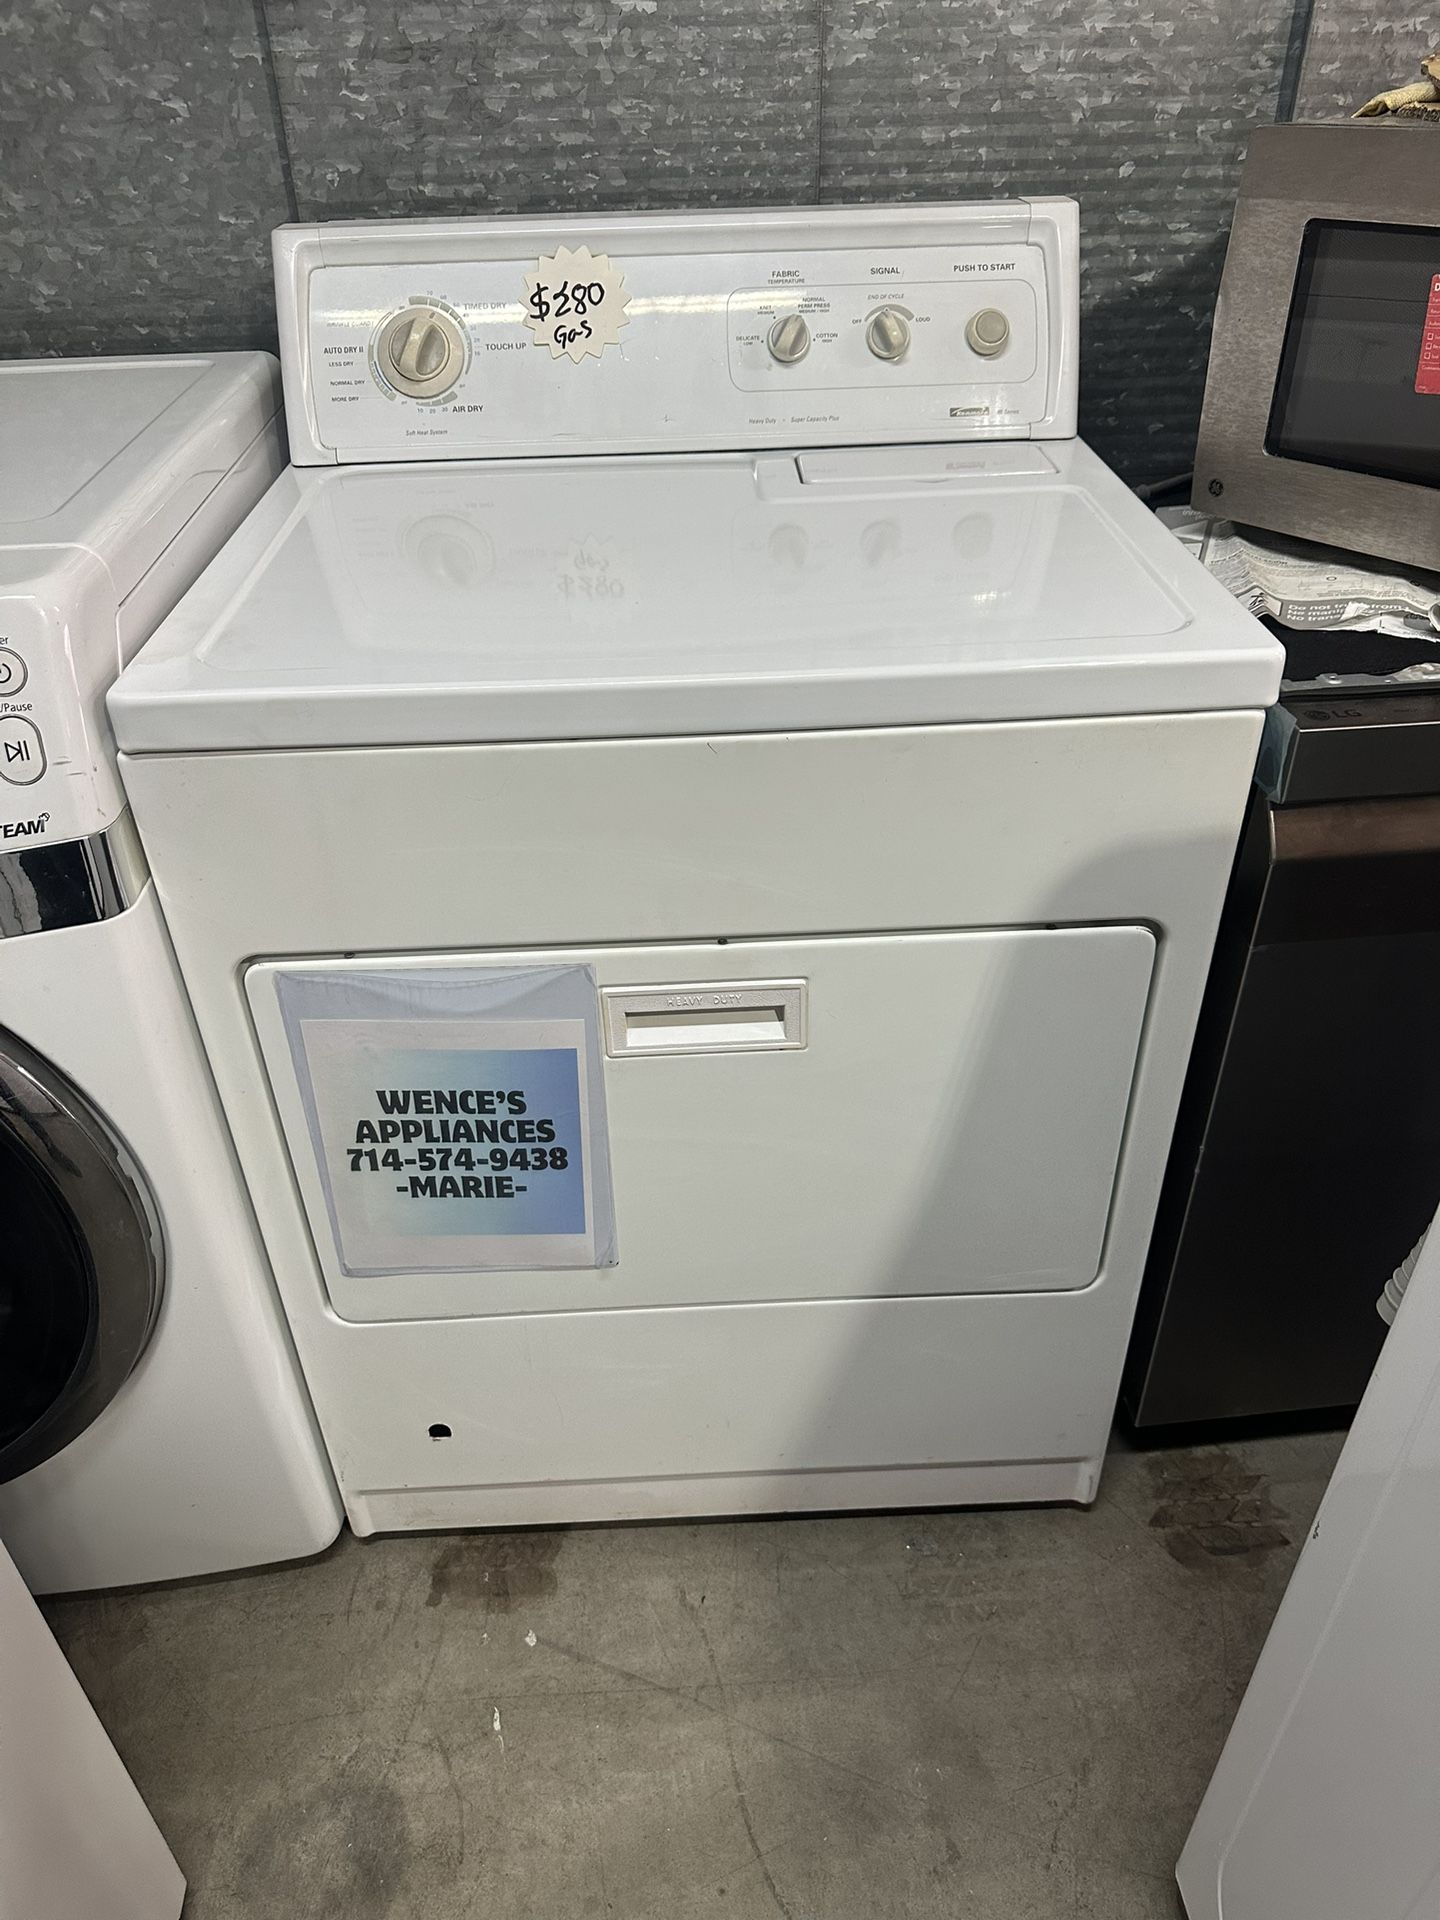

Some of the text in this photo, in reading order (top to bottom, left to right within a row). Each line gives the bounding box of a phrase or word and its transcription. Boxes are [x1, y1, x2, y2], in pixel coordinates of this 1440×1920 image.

[464, 302, 506, 310] TIMED DRY
[529, 280, 605, 322] $280
[323, 346, 342, 354] AUTO
[344, 346, 356, 354] DRY
[485, 342, 526, 350] TOUCH UP
[1332, 708, 1362, 719] LG
[666, 993, 744, 1008] HEAVY DUTY
[375, 1089, 527, 1115] WENCE'S
[355, 1118, 556, 1144] APPLIANCES
[346, 1146, 569, 1172] 714-574-9438
[396, 1175, 528, 1199] -MARIE-
